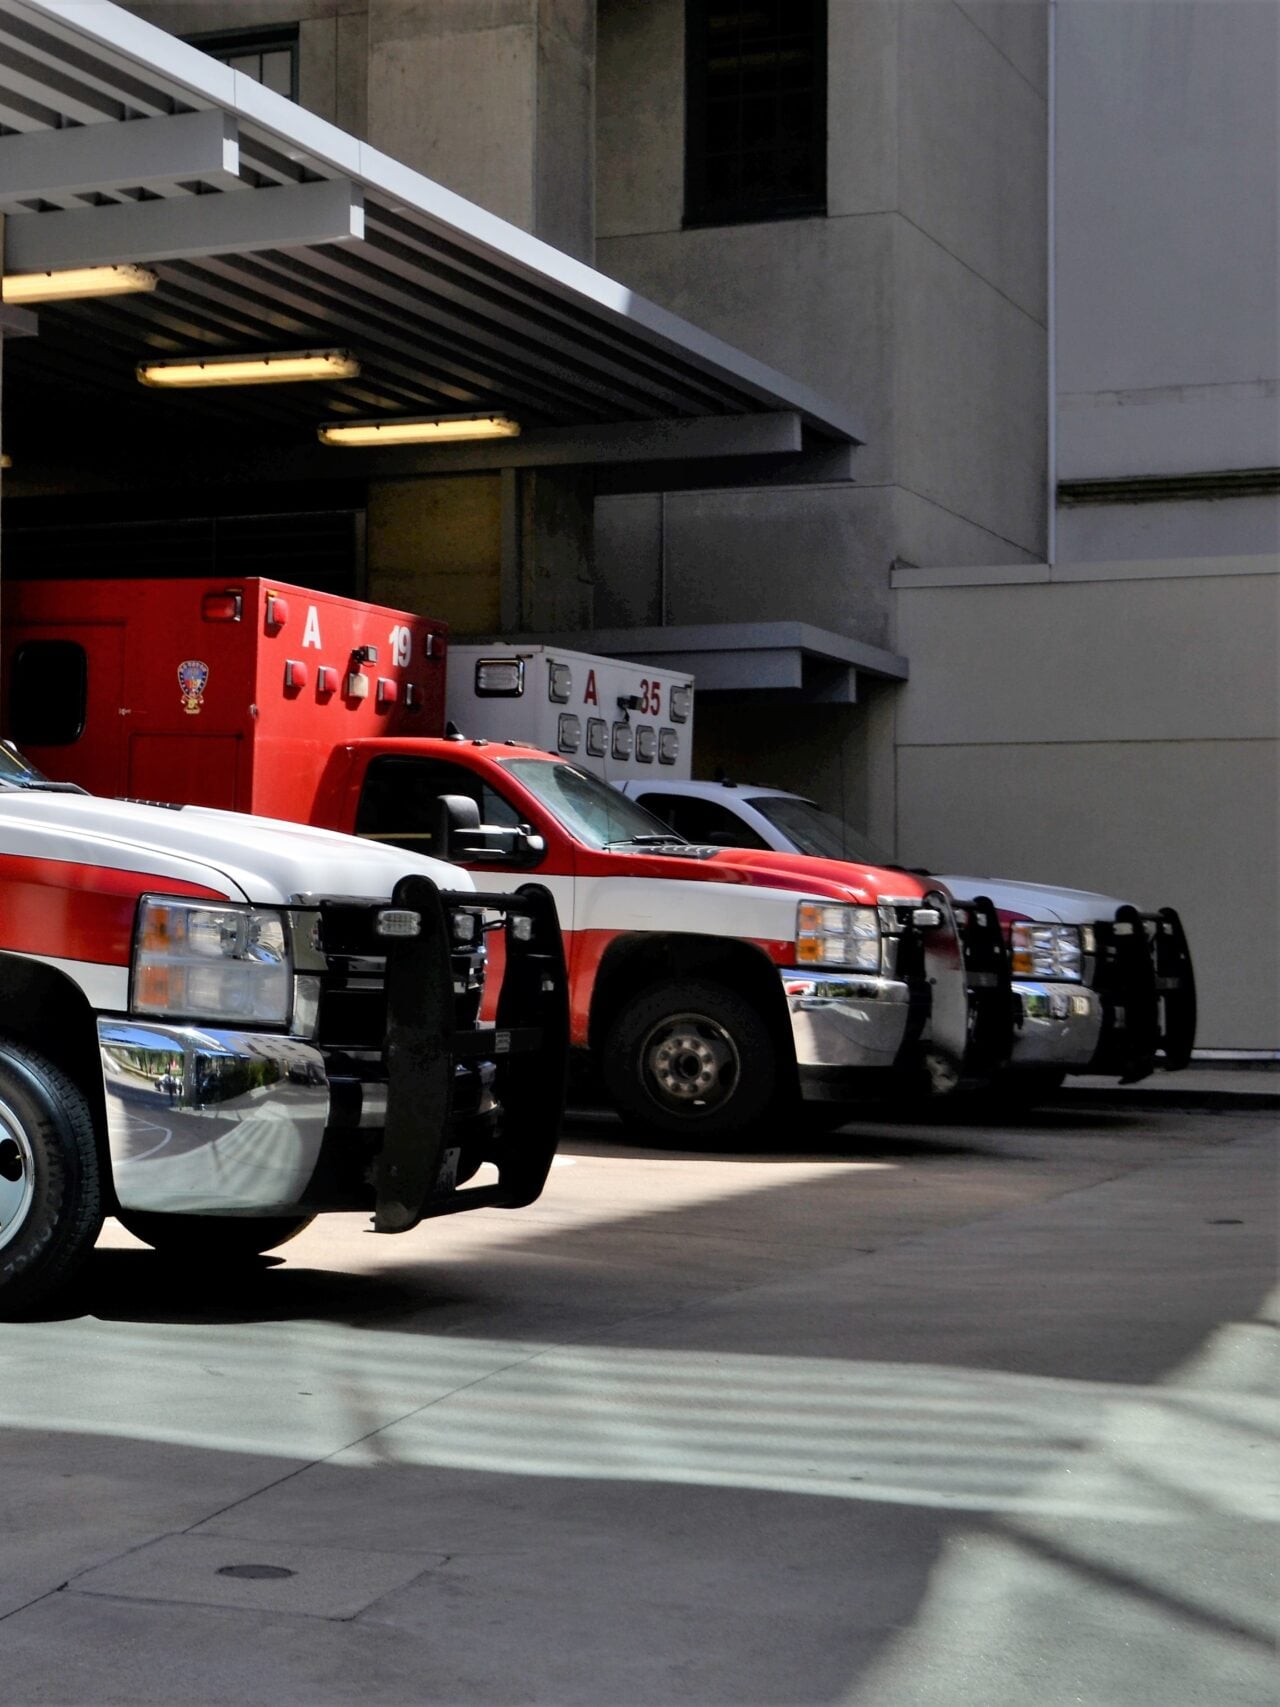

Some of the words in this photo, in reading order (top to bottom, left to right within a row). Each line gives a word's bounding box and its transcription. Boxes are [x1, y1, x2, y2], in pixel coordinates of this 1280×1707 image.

[302, 605, 322, 650] A
[389, 625, 412, 667] 19
[583, 669, 598, 706] A
[640, 679, 661, 716] 35
